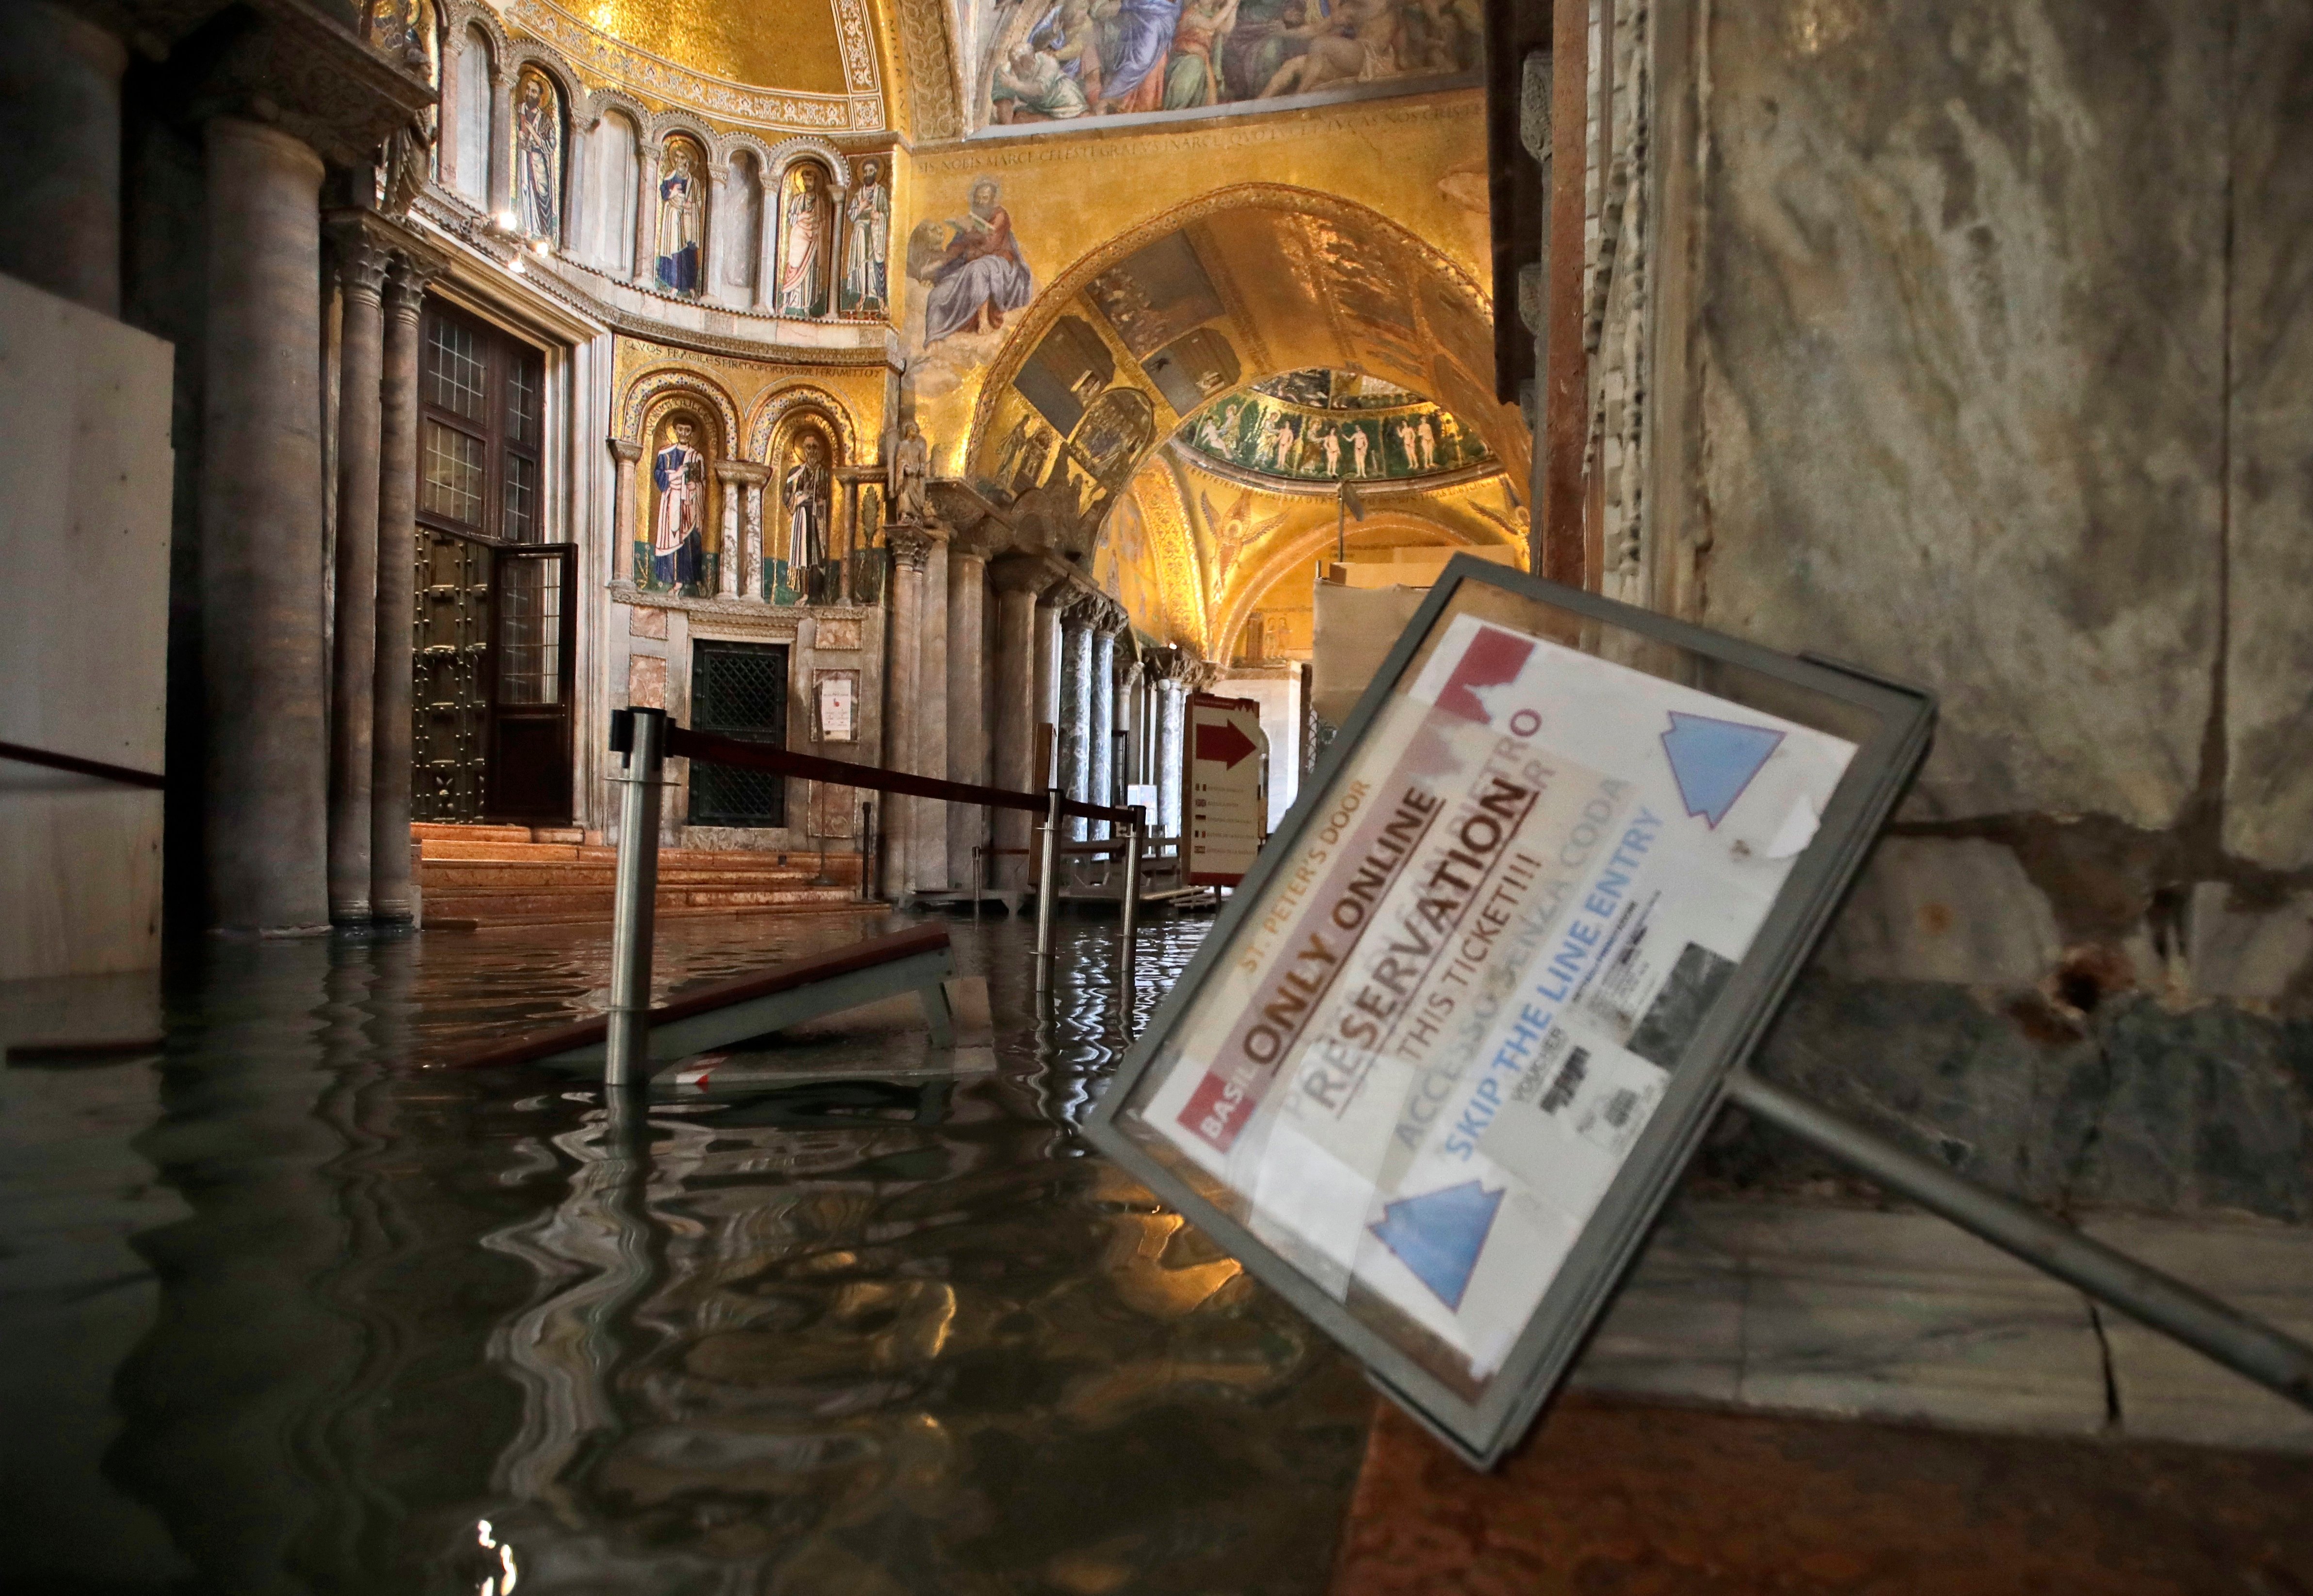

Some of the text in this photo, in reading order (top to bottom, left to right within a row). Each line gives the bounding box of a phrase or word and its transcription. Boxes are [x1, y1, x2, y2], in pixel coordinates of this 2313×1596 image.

[1237, 785, 1438, 1070] ONLY ONLINE
[1262, 844, 1328, 935] PETER'S
[1318, 778, 1371, 847] DOOR
[1301, 775, 1528, 1110] RESERVATION
[1556, 774, 1631, 872] CODA
[1396, 989, 1457, 1062] THIS
[1441, 850, 1543, 990] TICKET!!!
[1443, 1076, 1510, 1163] SKIP
[1491, 1001, 1554, 1079] THE
[1536, 919, 1601, 1004] LINE
[1582, 806, 1665, 920] ENTRY
